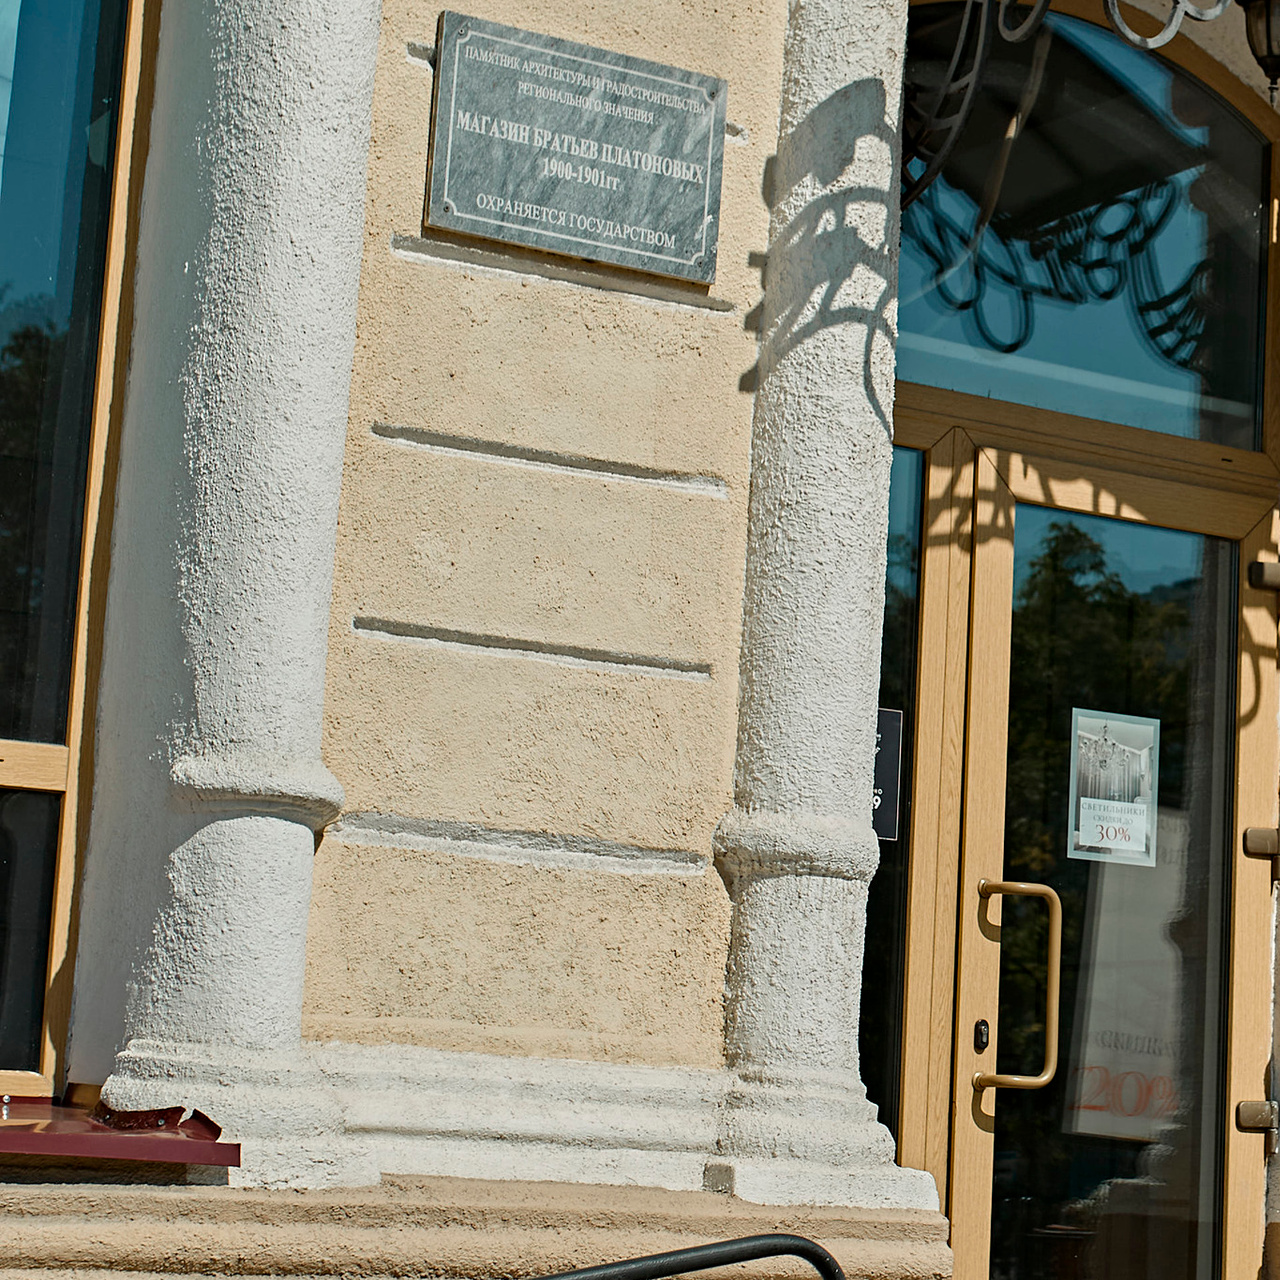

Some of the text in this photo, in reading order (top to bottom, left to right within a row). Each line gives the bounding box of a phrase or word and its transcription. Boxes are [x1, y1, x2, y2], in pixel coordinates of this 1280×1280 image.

[465, 45, 706, 115] ПАМЯТНИК АРХИТЕКТУРЫ И ГРАДОСТРОИТЕЛЬСТВА
[517, 81, 654, 124] РЕГИОНАЛЬНОГО ЗНАЧЕНИЯ
[456, 109, 704, 184] МАГАЗИН БРАТЬЕВ ПЛАТОНОВЫХ
[476, 193, 676, 249] ОХРАНЯЕТСЯ ГОСУДАРСТВОМ
[1082, 802, 1145, 817] СВЕТИЛЬНИКИ
[1095, 824, 1131, 843] 30%
